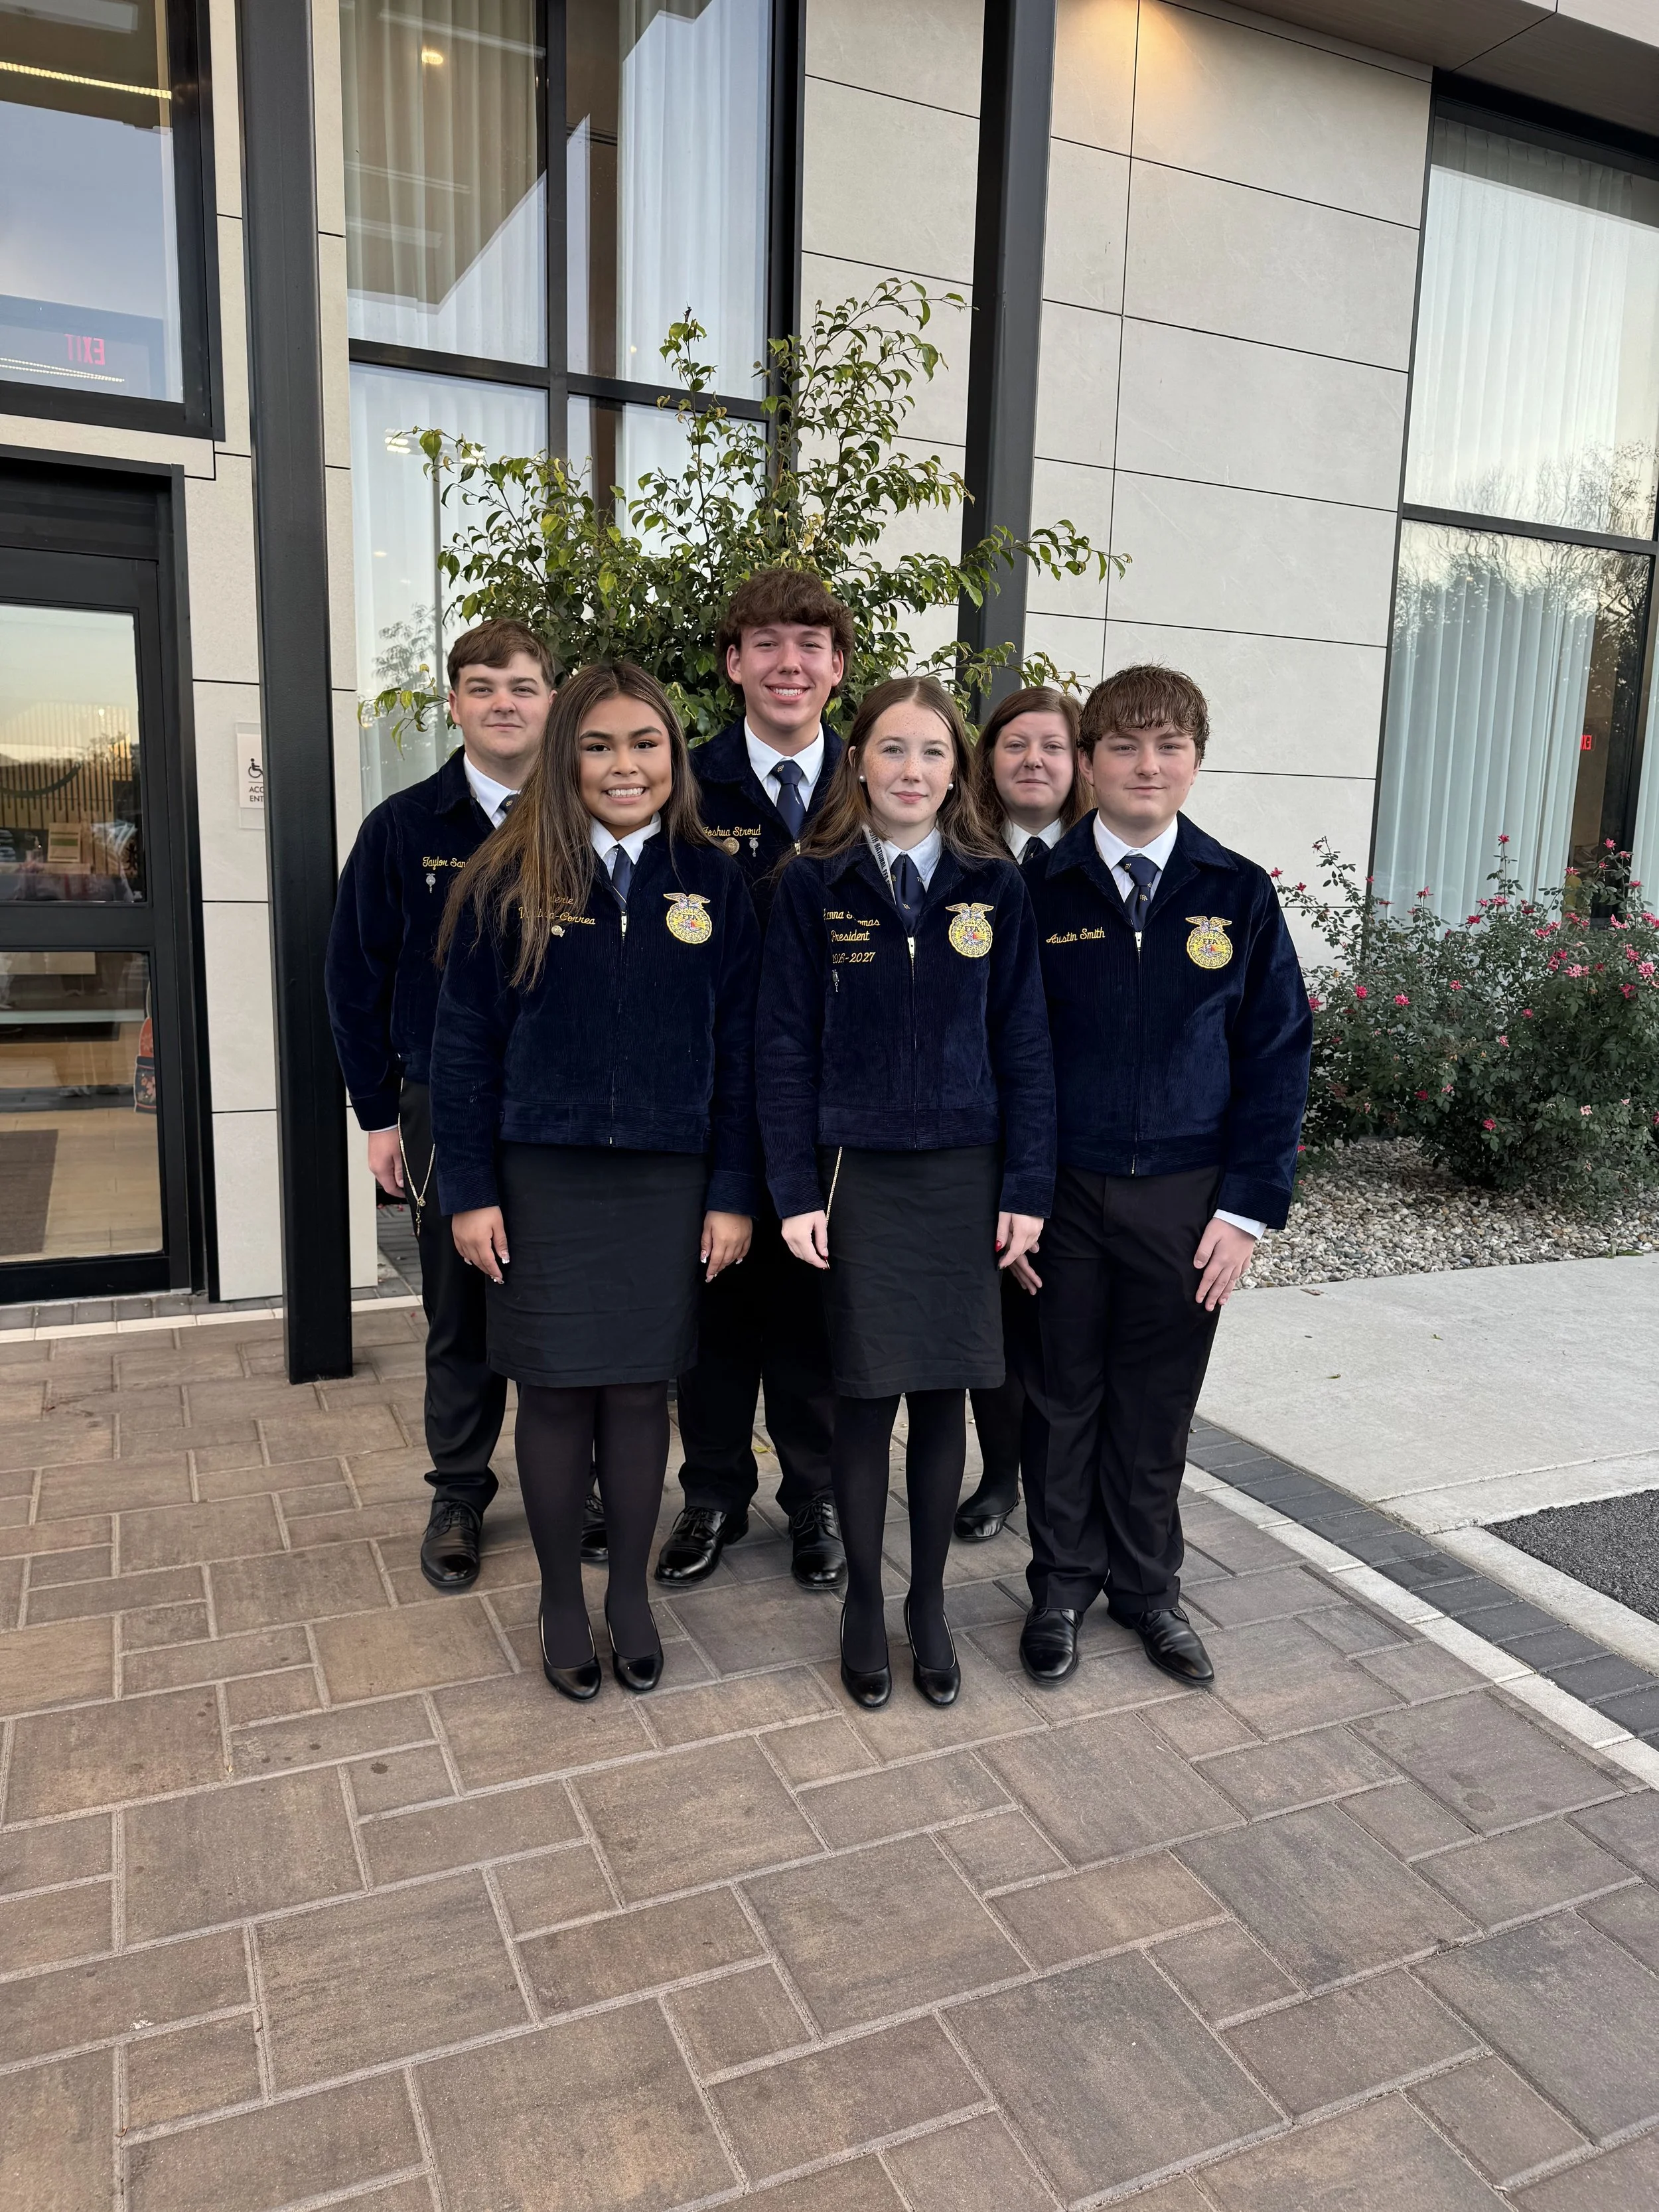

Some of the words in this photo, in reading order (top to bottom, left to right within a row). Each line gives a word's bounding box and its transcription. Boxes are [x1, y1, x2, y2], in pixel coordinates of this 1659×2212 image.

[733, 824, 762, 836] Stroud
[423, 856, 449, 870] Taylor
[874, 843, 886, 870] NATIONAL
[831, 929, 871, 942] President
[1046, 932, 1078, 944] Austin
[1080, 926, 1106, 940] Smith
